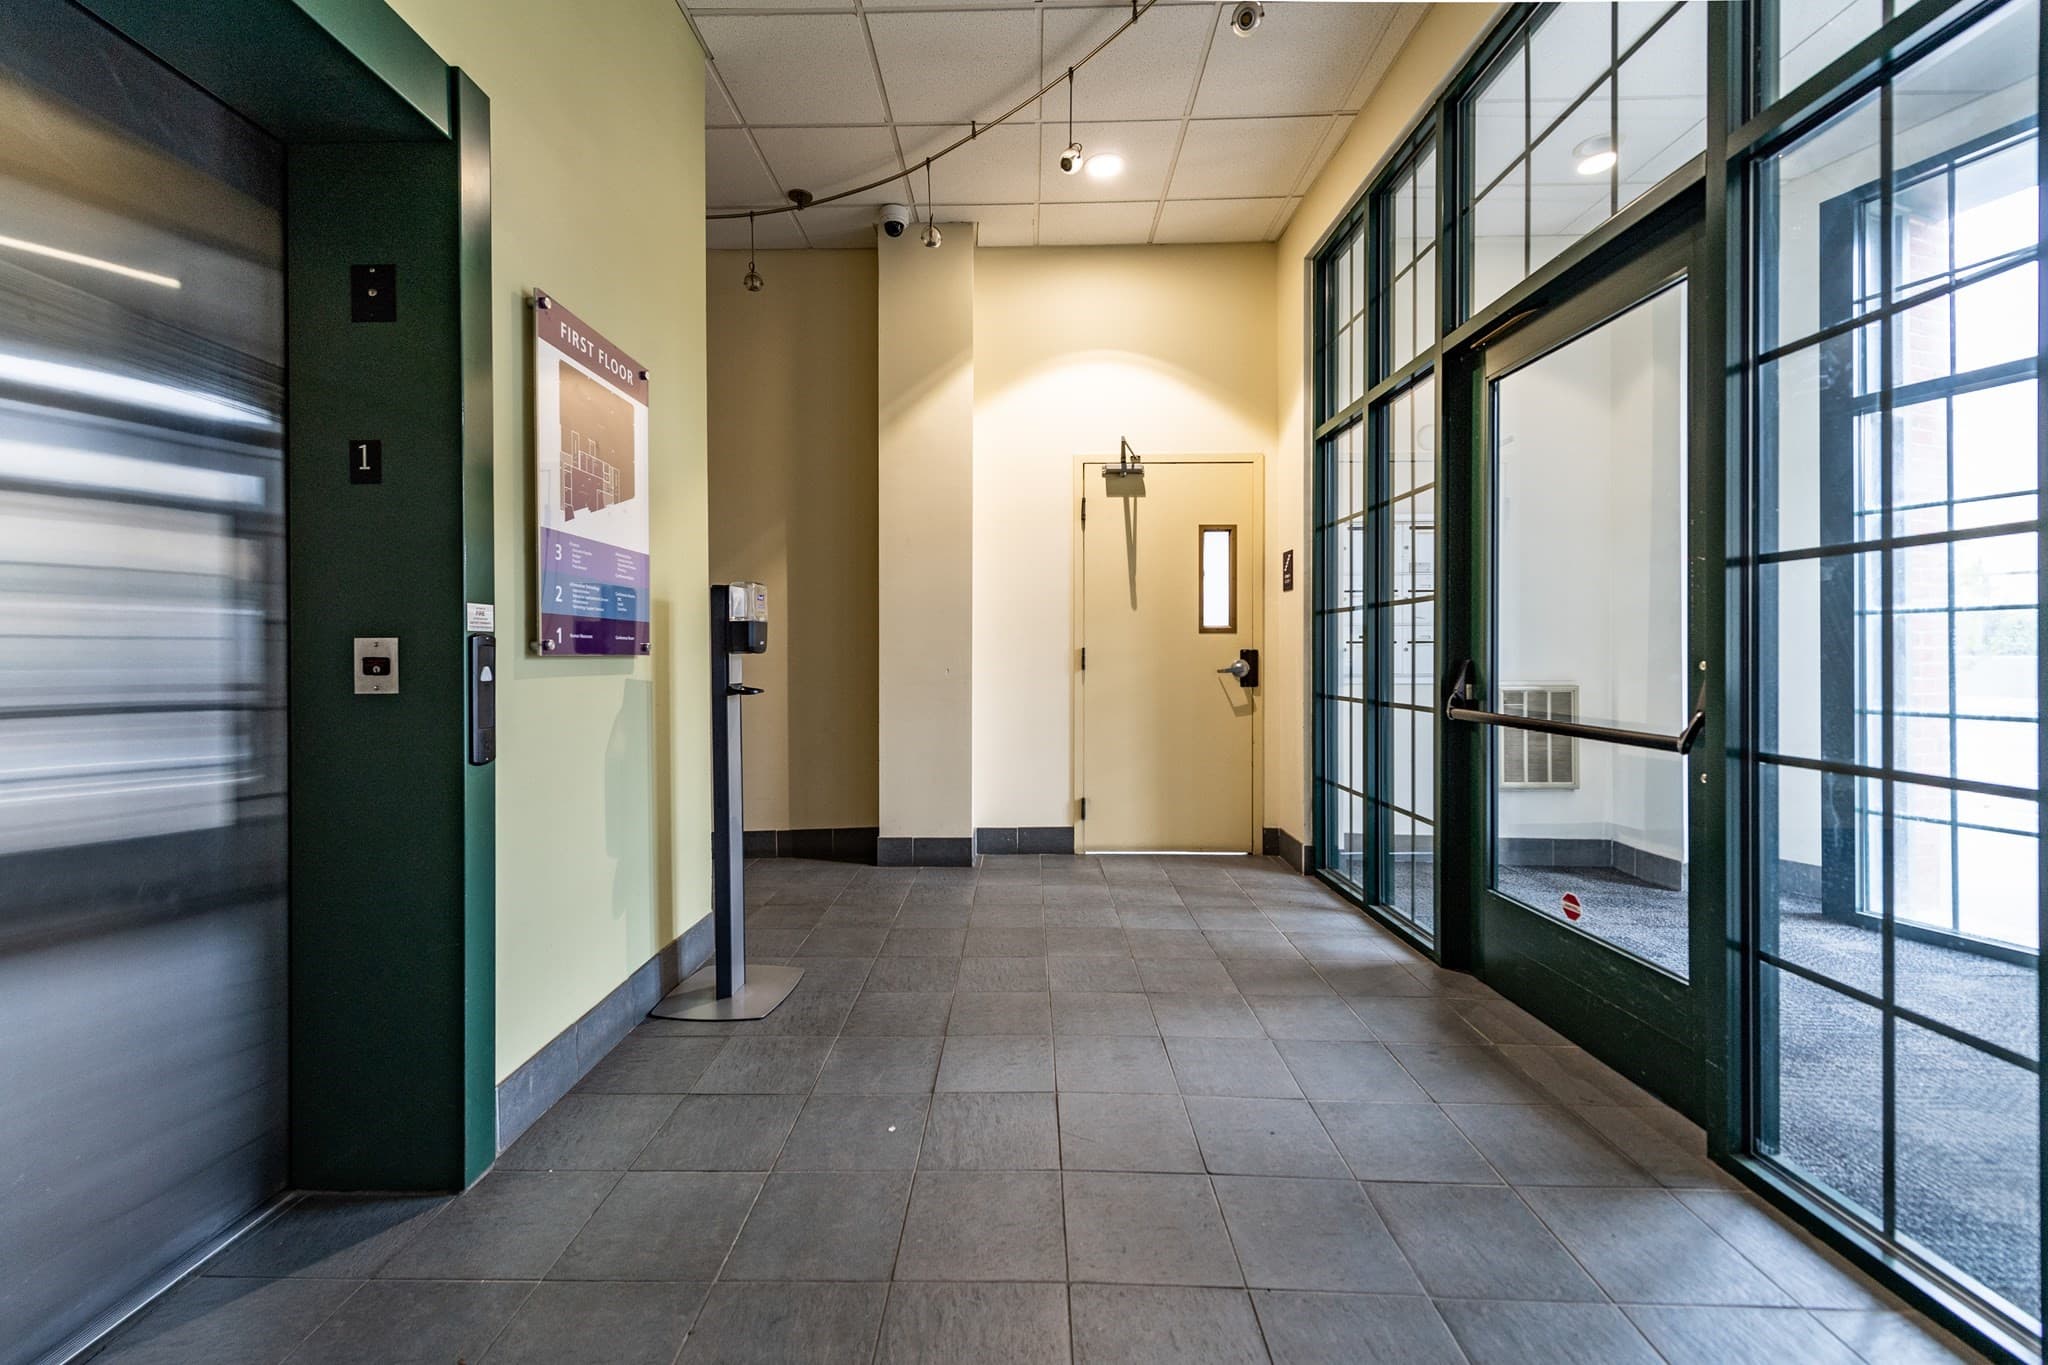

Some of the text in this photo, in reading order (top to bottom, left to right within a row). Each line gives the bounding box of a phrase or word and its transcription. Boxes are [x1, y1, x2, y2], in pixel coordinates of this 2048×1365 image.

[560, 321, 634, 386] FIRST FLOOR
[358, 444, 371, 470] 1
[555, 543, 562, 561] 3
[555, 585, 563, 602] 2
[556, 626, 562, 644] 1
